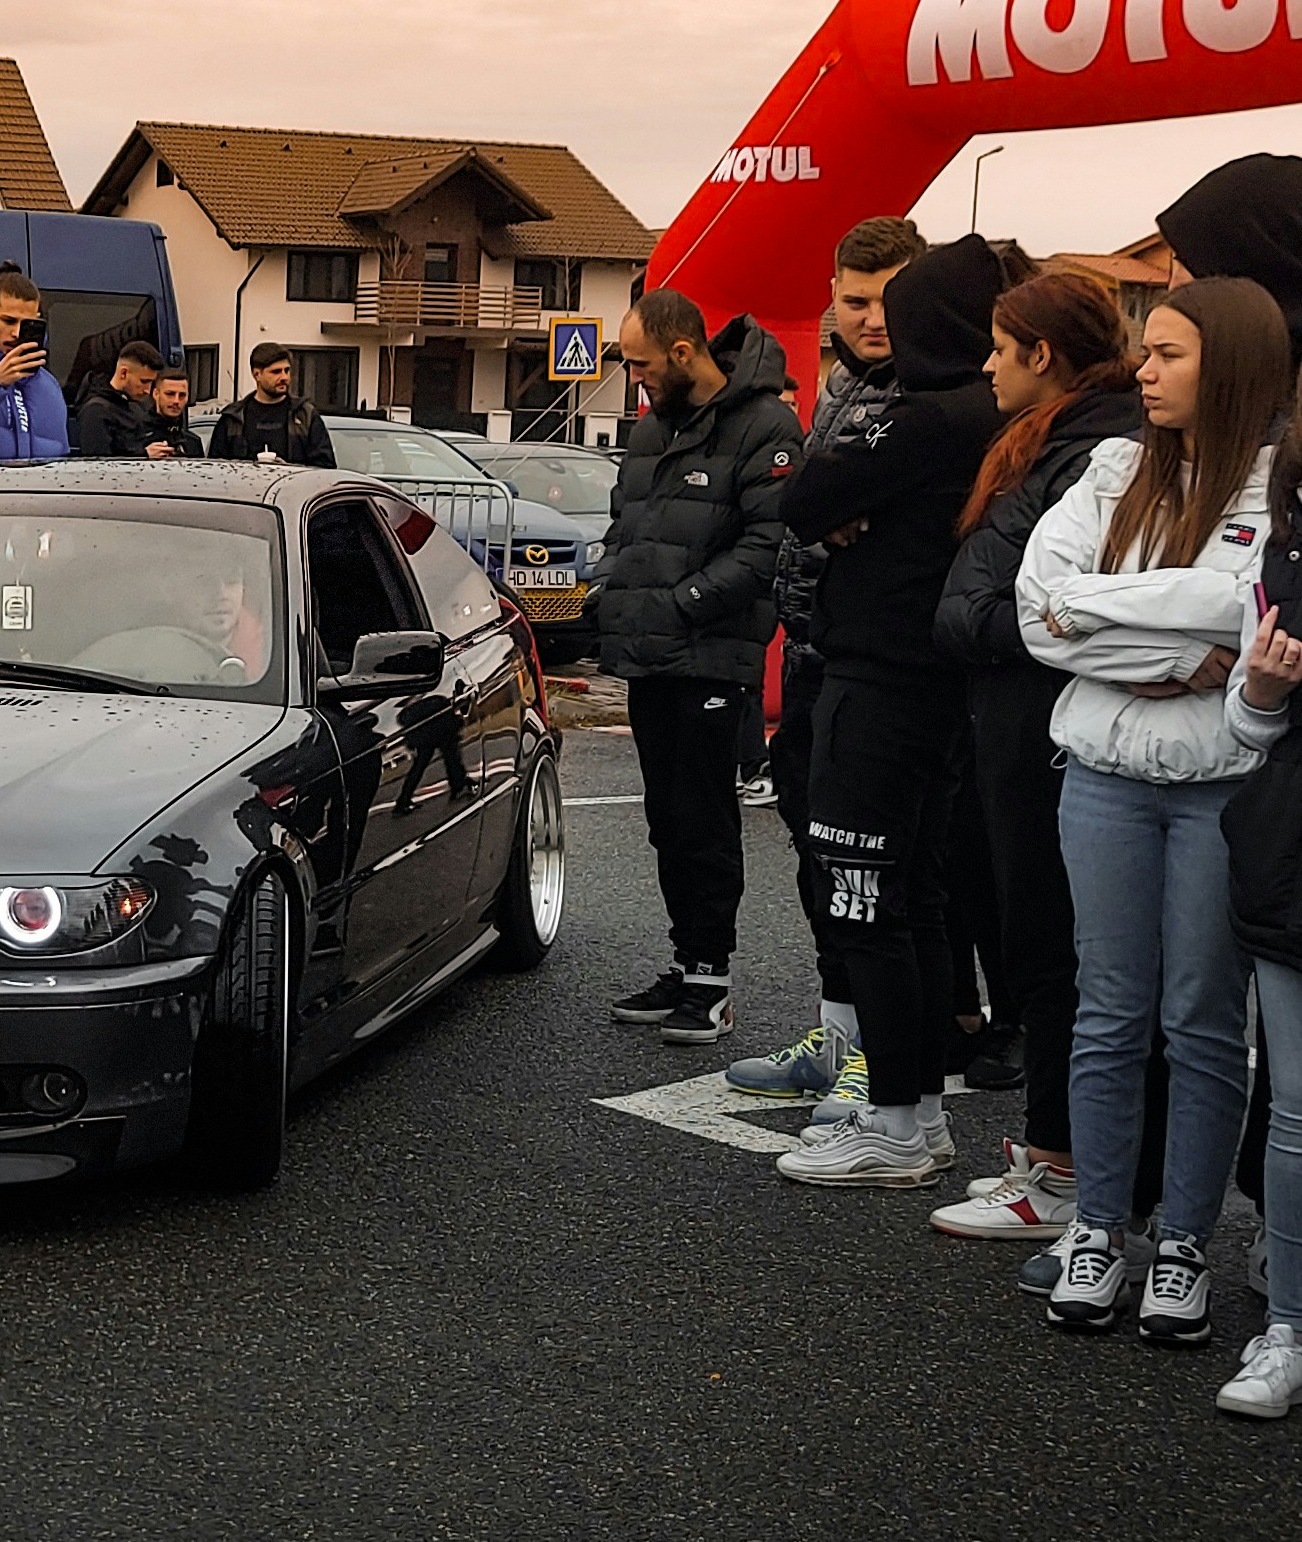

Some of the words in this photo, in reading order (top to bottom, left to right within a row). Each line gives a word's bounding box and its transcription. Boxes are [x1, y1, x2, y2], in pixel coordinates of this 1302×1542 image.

[709, 146, 820, 184] MOTUL
[532, 571, 544, 586] 14
[548, 571, 572, 586] LDL
[808, 821, 856, 846] WATCH
[859, 834, 886, 850] THE
[831, 867, 880, 896] SUN
[830, 891, 877, 923] SET
